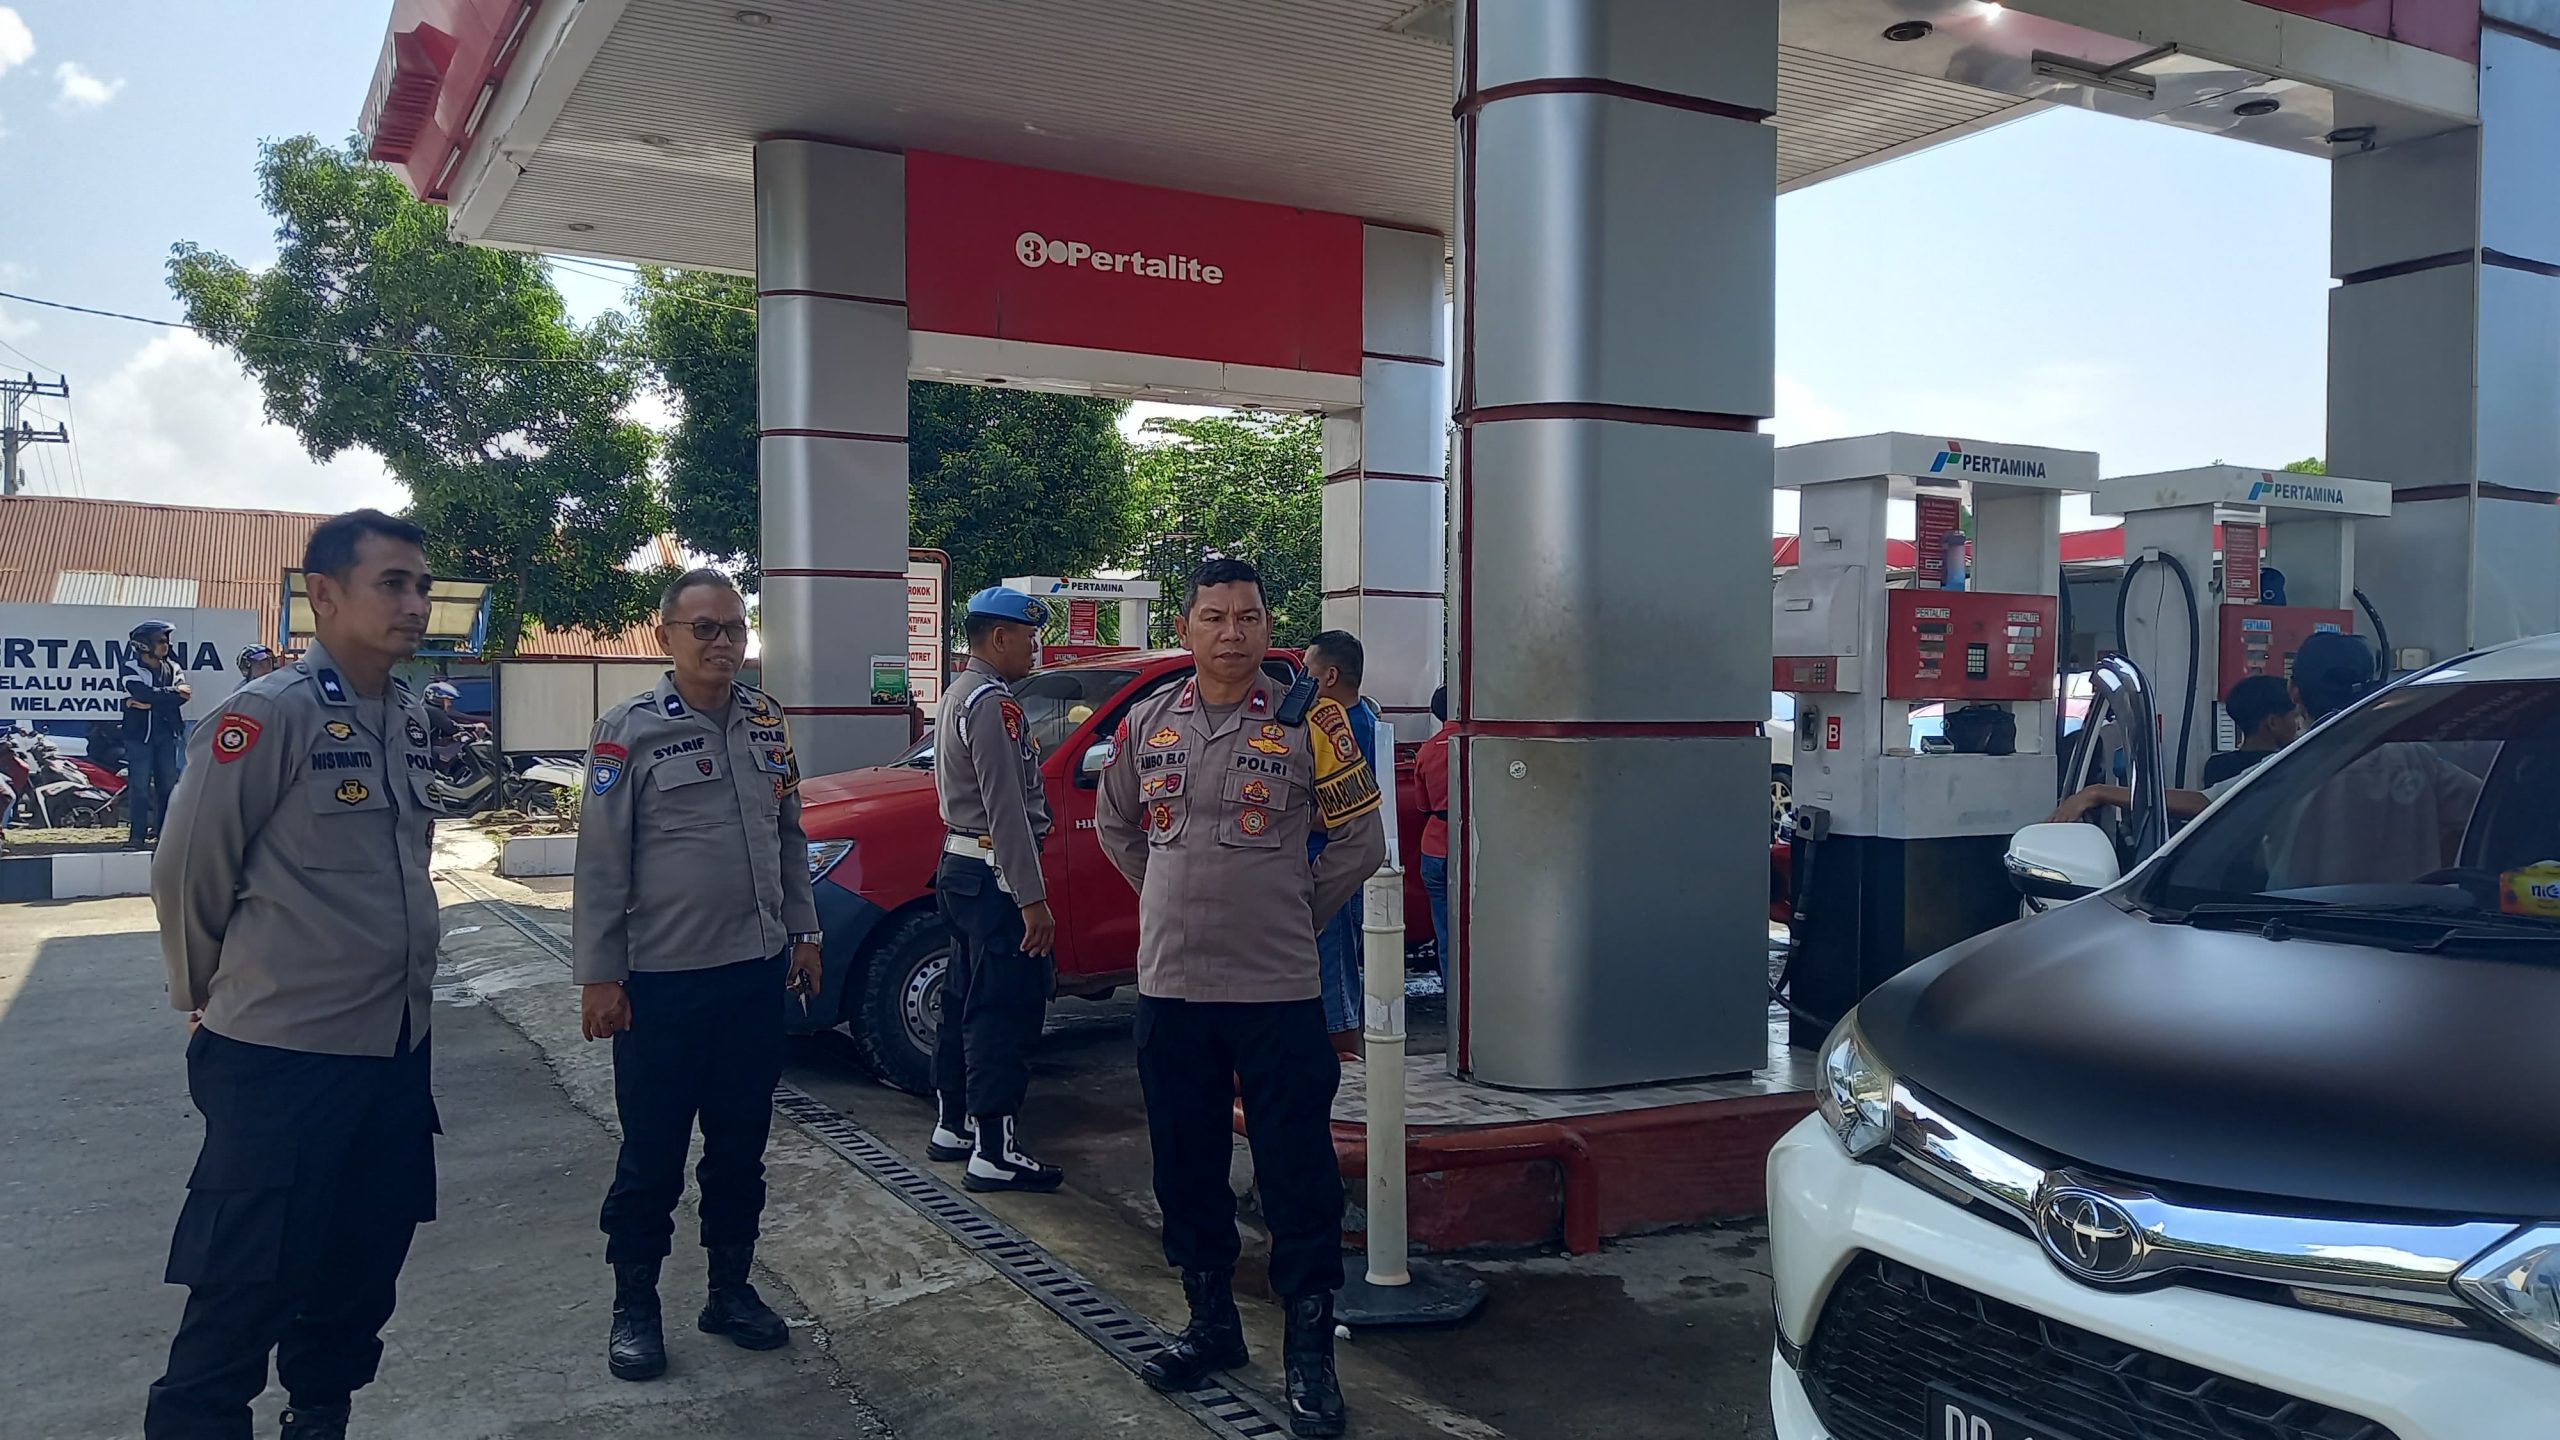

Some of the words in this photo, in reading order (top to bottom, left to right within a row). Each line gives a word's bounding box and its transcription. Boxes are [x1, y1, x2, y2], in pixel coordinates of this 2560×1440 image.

[1067, 241, 1224, 285] Pertalite
[1963, 454, 2046, 479] PERTAMINA
[2275, 483, 2344, 504] PERTAMINA
[1071, 582, 1124, 593] PERTAMINA
[1916, 608, 1949, 617] PERTALITE
[0, 638, 224, 671] RTAMNA
[1828, 724, 1839, 742] B
[653, 737, 705, 759] SYARIF
[311, 751, 373, 771] NISWANTO
[1140, 754, 1163, 771] AMBO
[1166, 751, 1186, 765] ELO
[1236, 756, 1288, 776] POLRI
